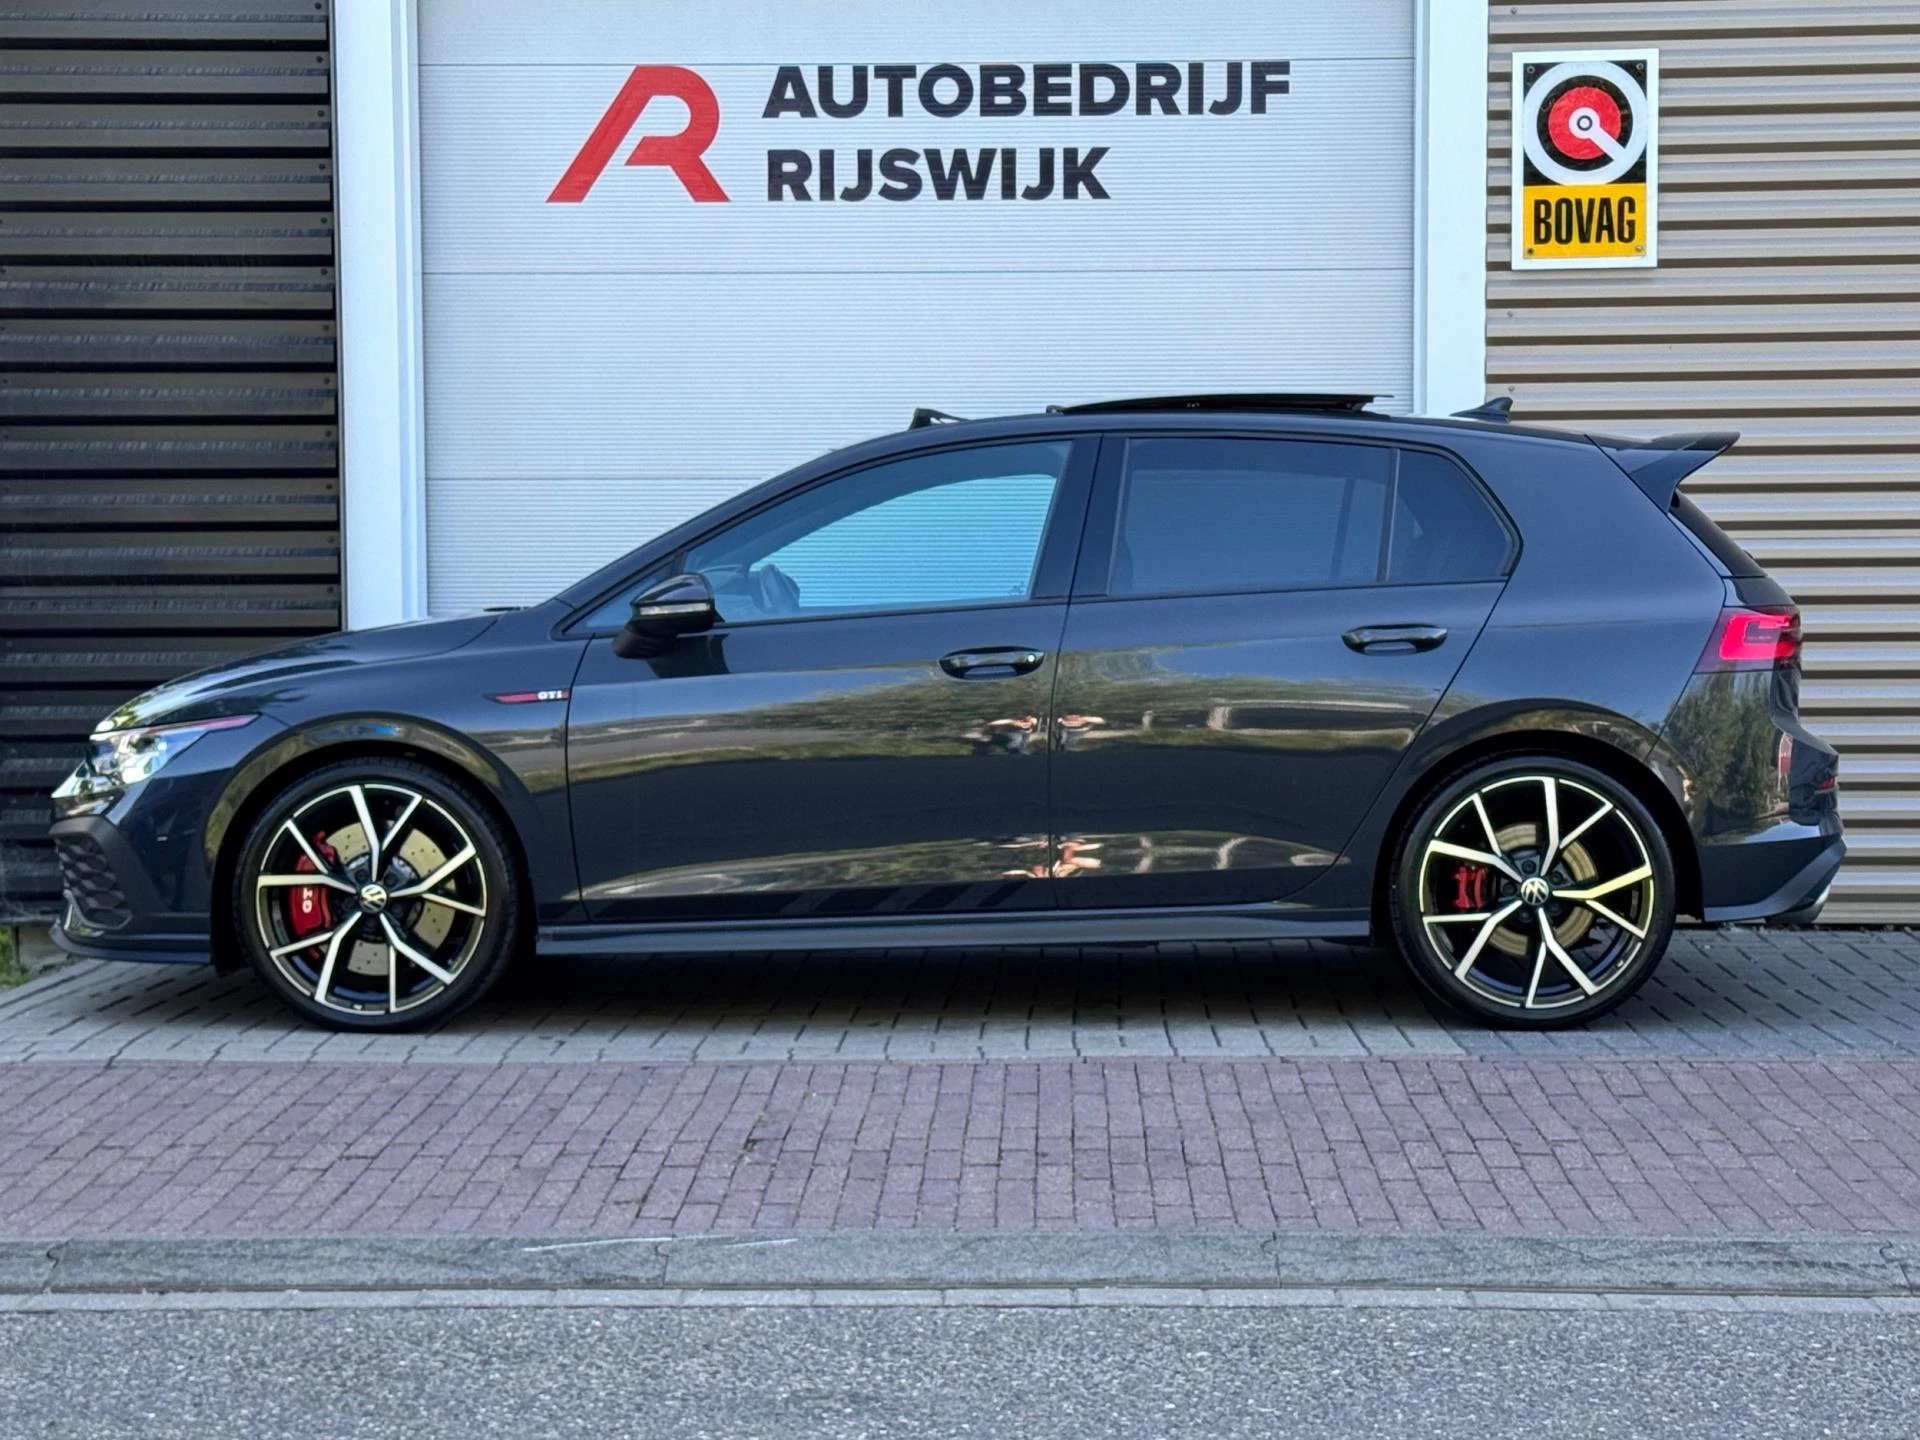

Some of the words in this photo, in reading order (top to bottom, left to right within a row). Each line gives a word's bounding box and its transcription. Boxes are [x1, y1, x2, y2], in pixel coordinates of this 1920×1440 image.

[762, 61, 1290, 119] AUTOBEDRIJF
[767, 147, 1111, 202] RIJSWIJK
[1533, 196, 1636, 245] BOVAG
[537, 690, 562, 700] GTI
[302, 887, 313, 914] GT
